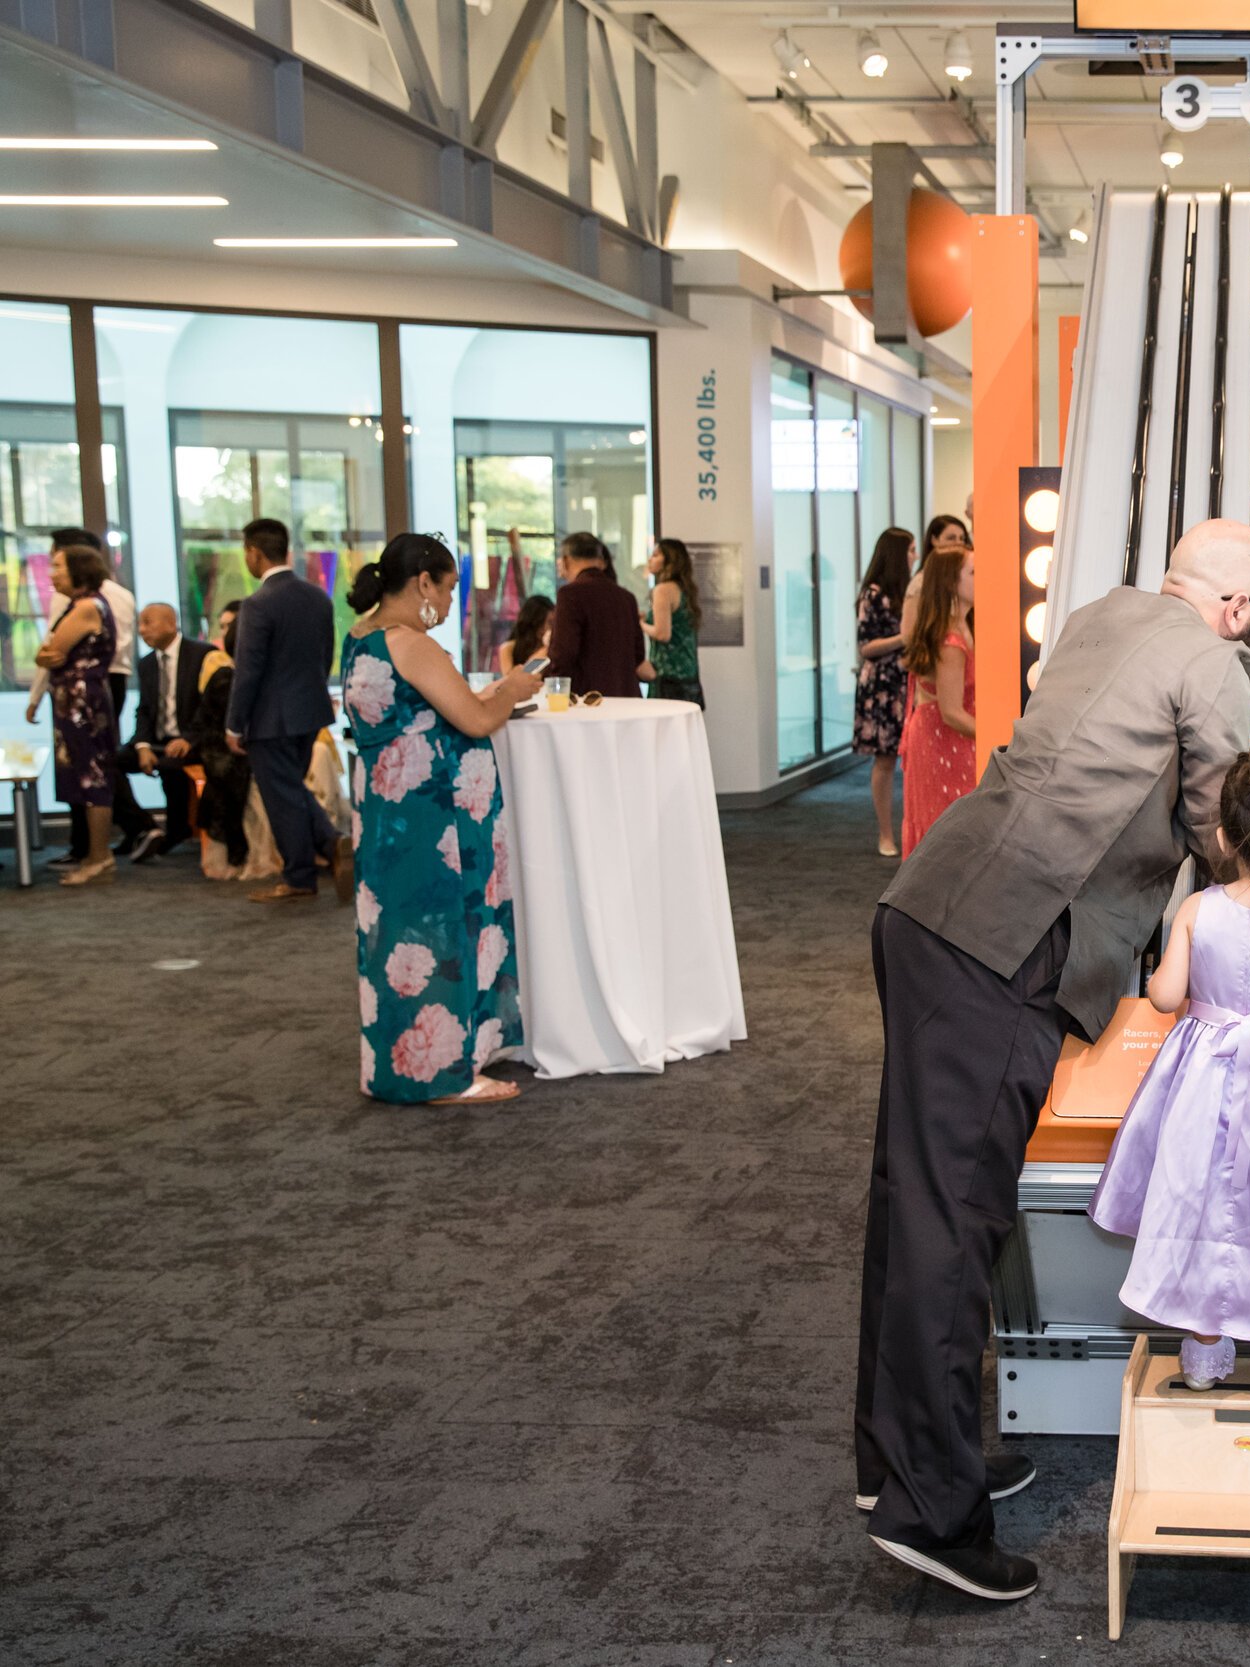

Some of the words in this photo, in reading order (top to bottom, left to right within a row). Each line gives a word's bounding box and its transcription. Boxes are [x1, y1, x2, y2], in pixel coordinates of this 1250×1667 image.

[1175, 83, 1200, 119] 3
[697, 369, 715, 409] lbs.
[698, 417, 718, 501] 35,400
[1122, 1042, 1149, 1051] your
[1123, 1028, 1161, 1039] Racers,
